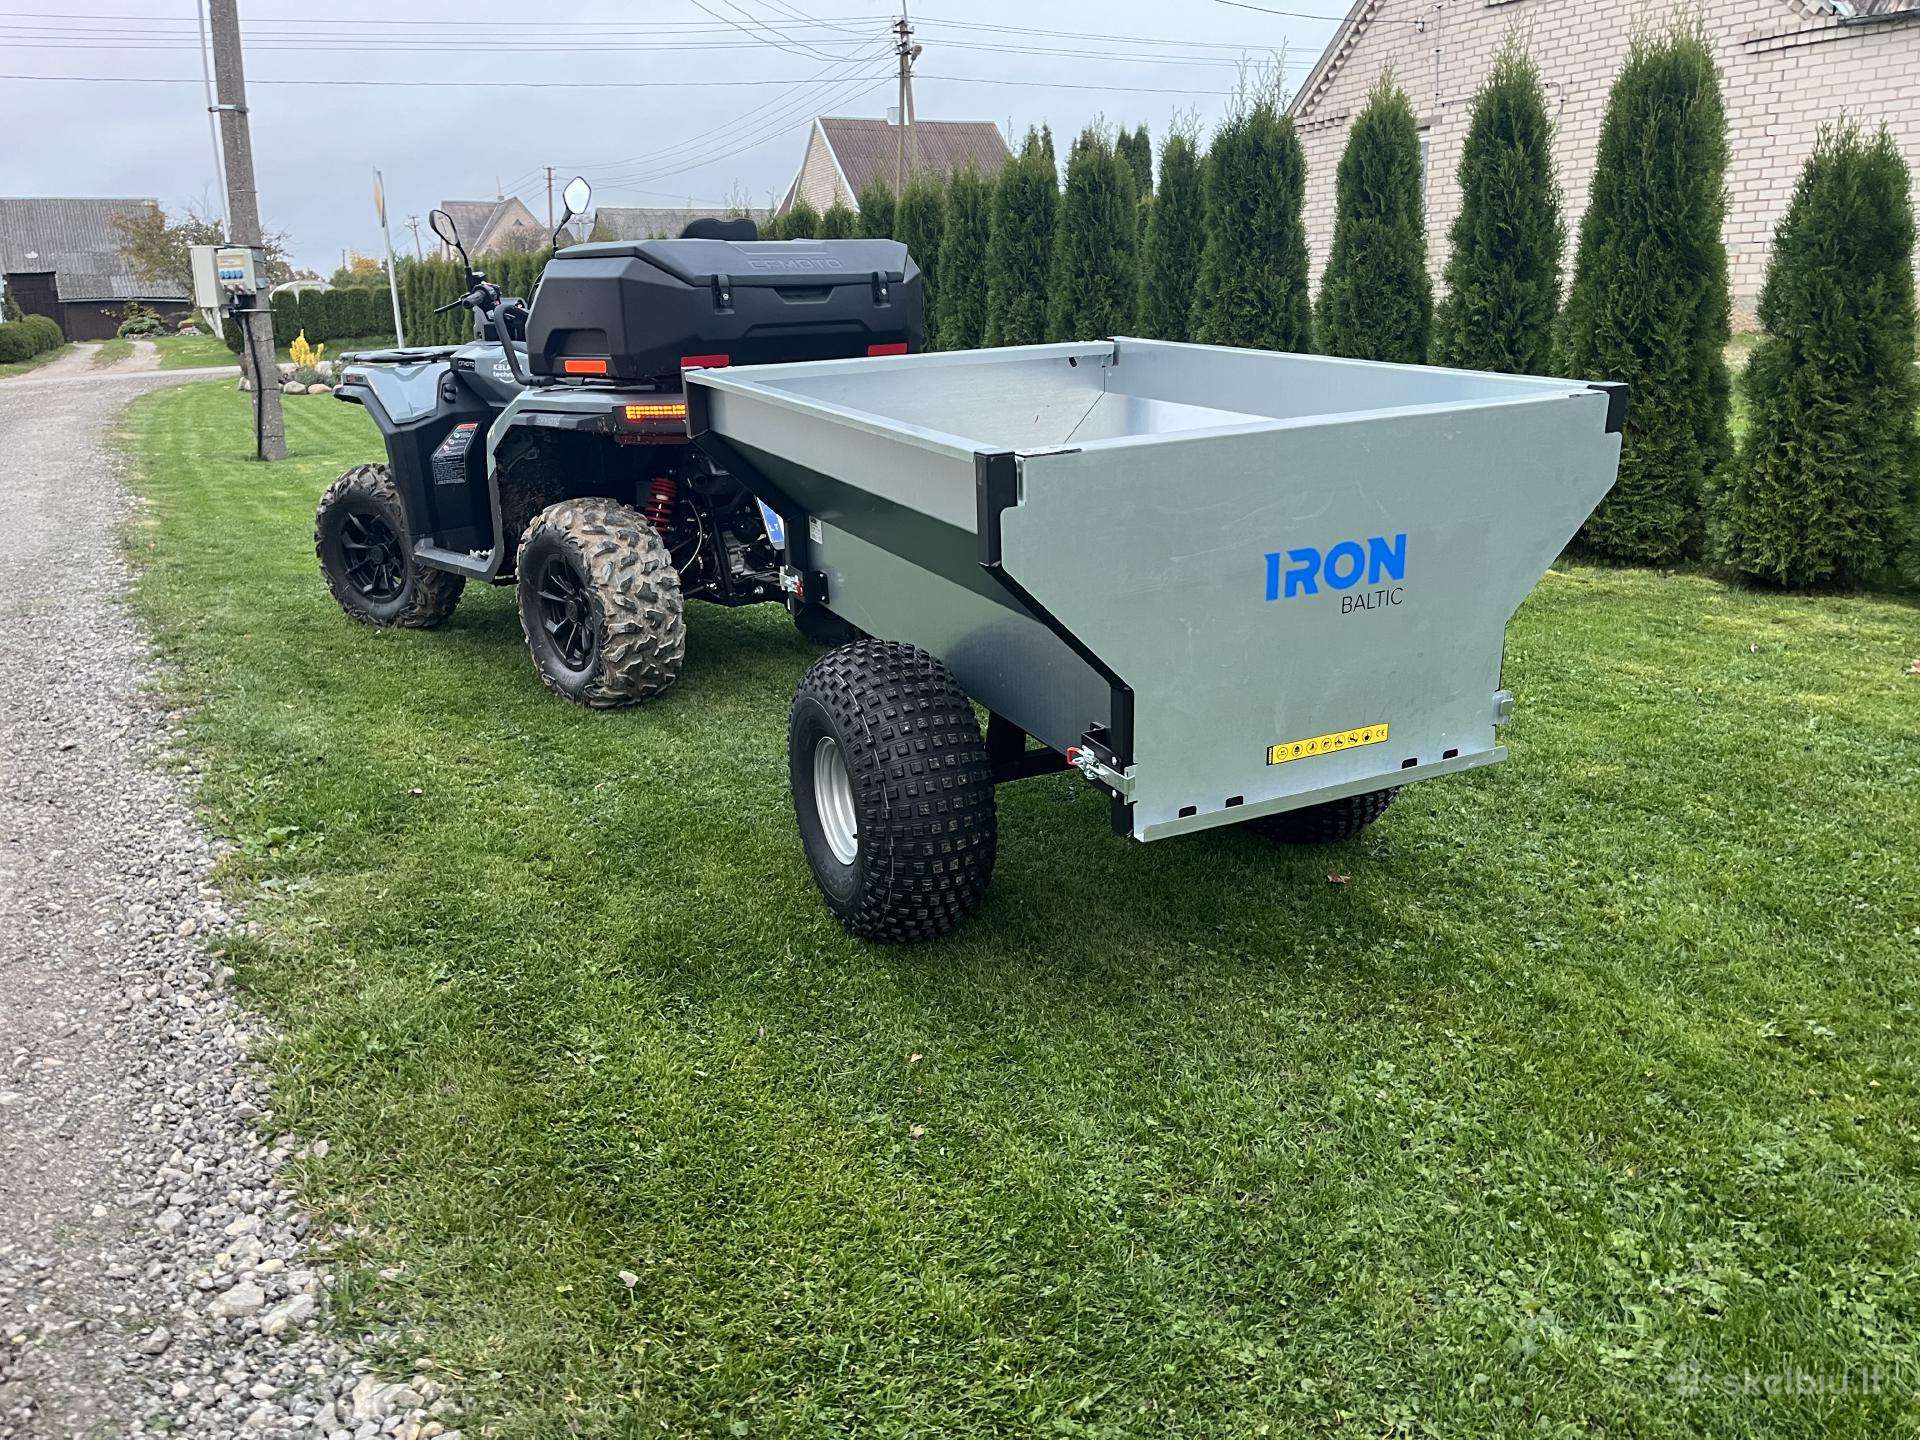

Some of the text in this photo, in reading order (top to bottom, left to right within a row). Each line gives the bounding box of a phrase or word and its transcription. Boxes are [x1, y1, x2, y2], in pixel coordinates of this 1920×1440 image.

[768, 523, 780, 532] LT
[1264, 533, 1407, 601] IRON
[1341, 587, 1403, 614] BALTIC
